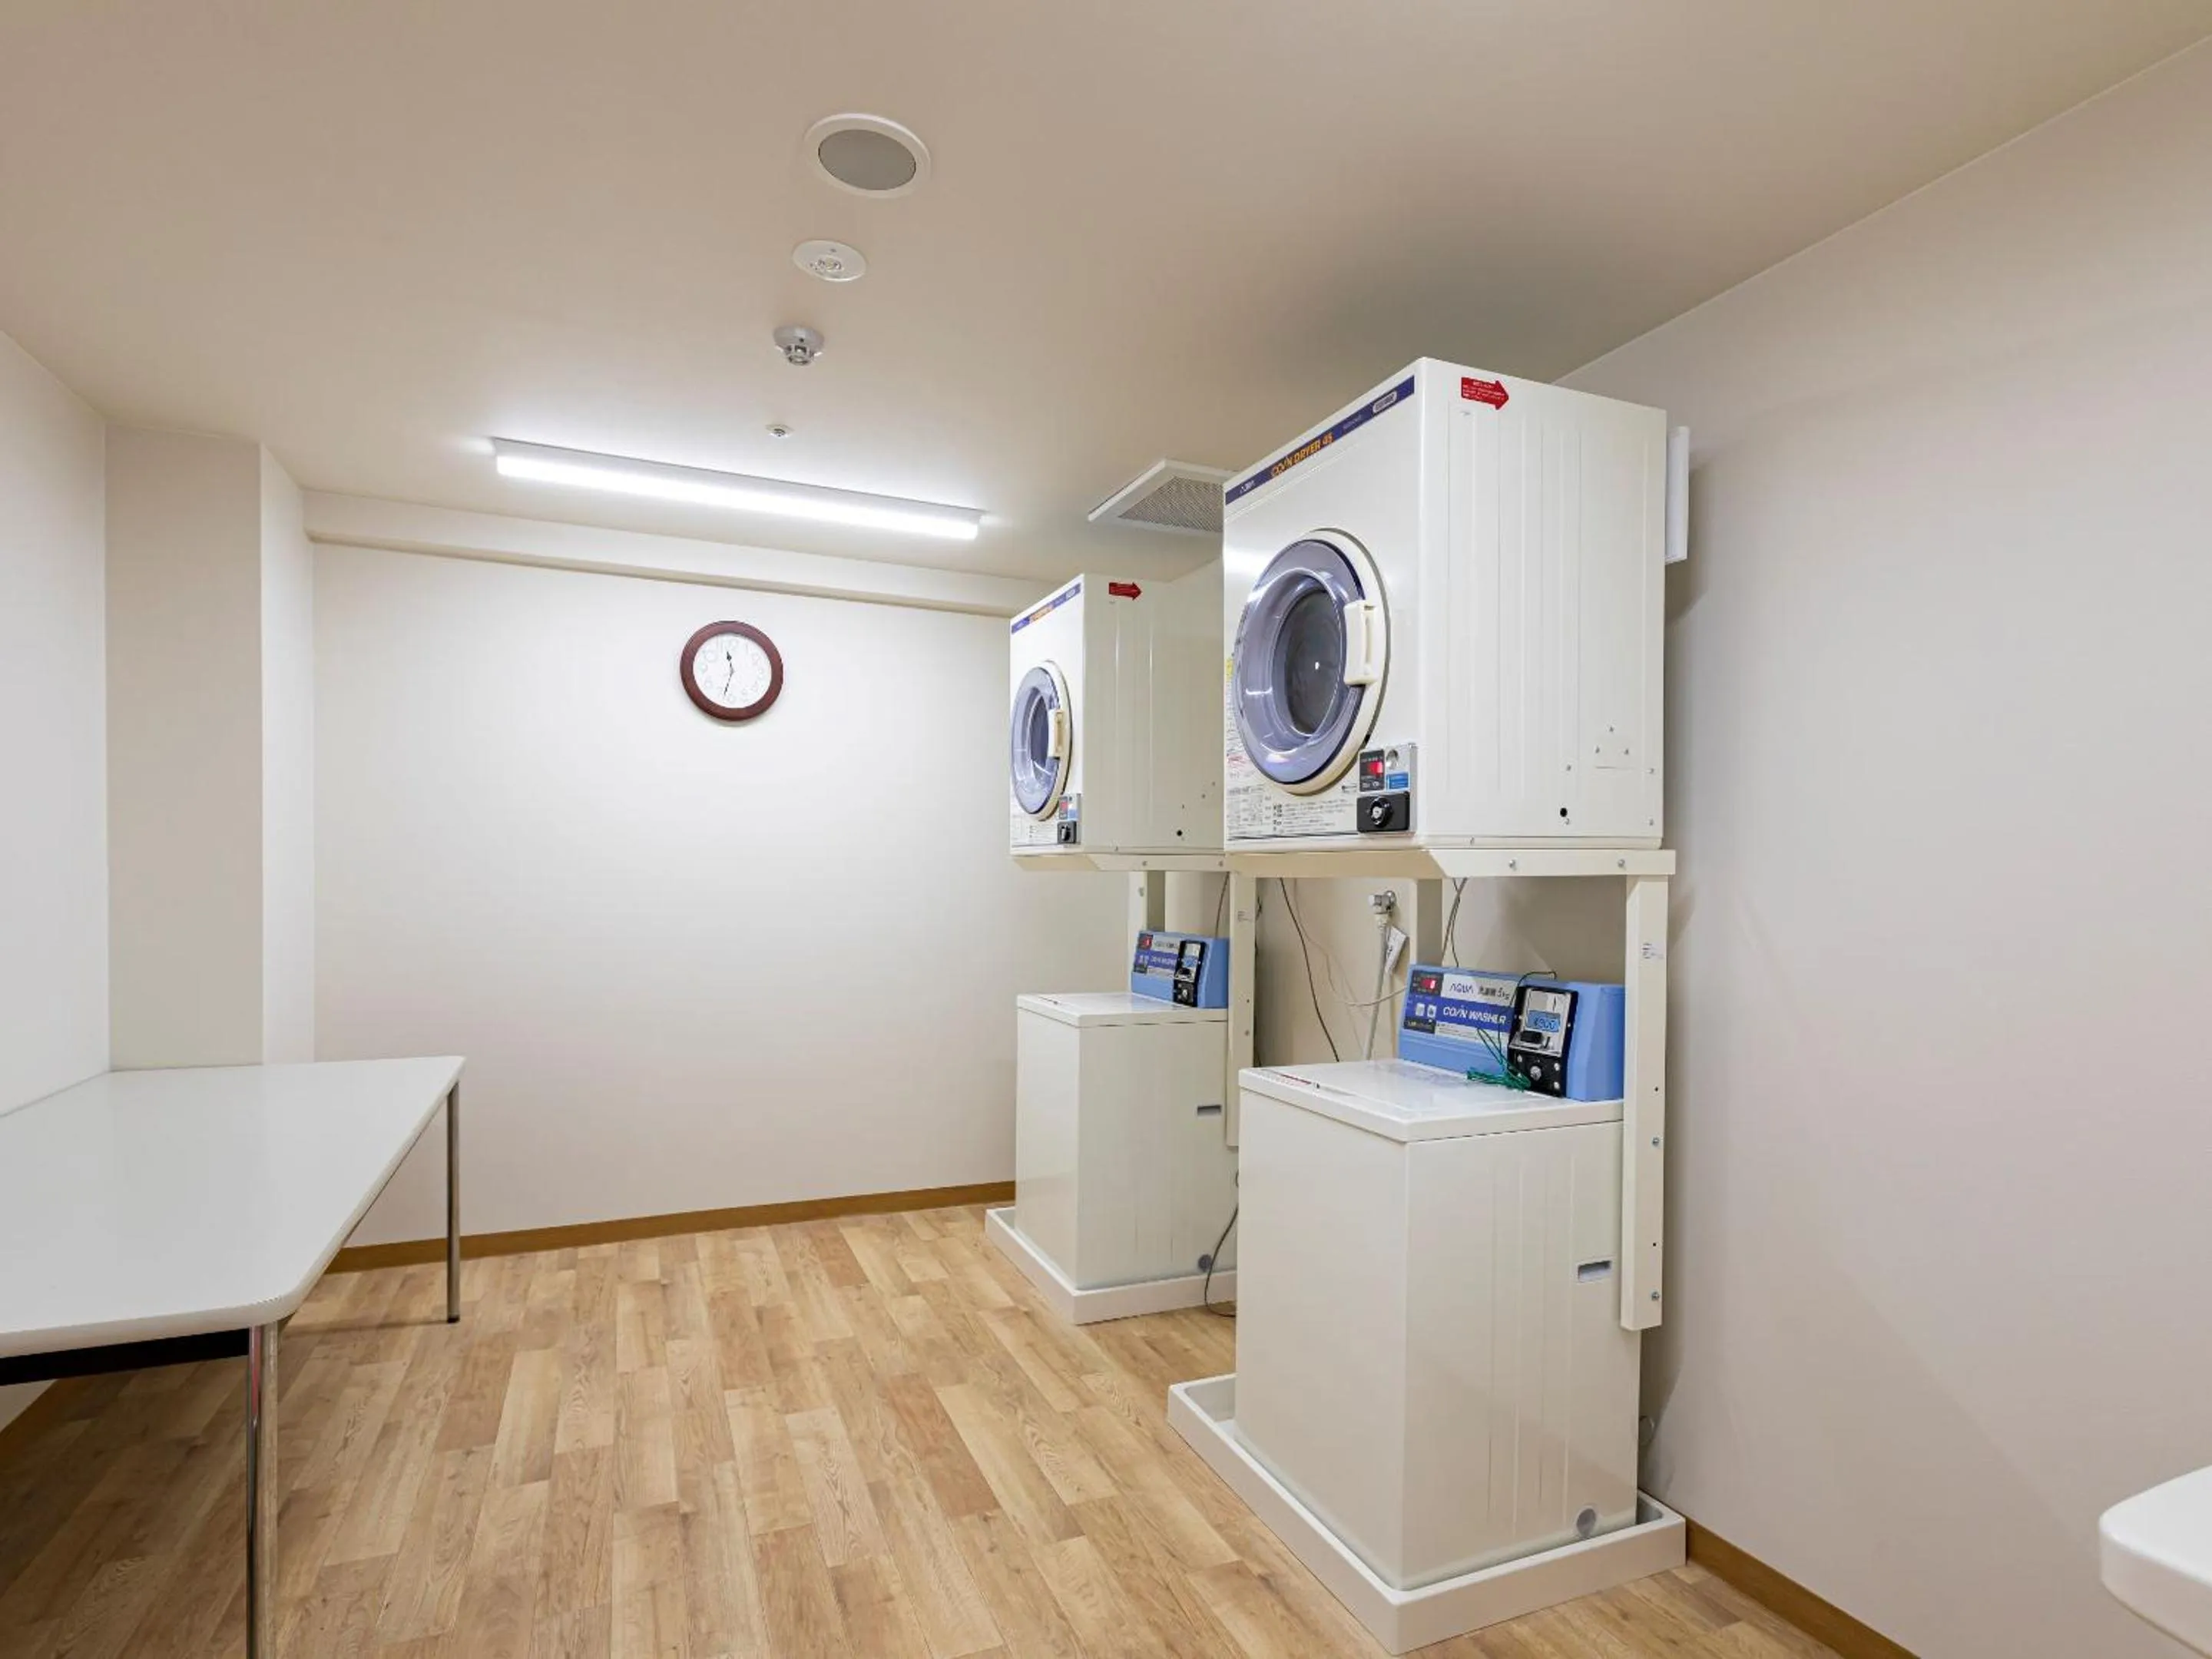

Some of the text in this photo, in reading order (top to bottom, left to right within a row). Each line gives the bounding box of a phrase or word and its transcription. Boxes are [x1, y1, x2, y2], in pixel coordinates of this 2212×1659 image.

[1293, 440, 1321, 462] DRYER
[1449, 982, 1474, 994] AQUA
[1469, 1010, 1507, 1025] WASHER
